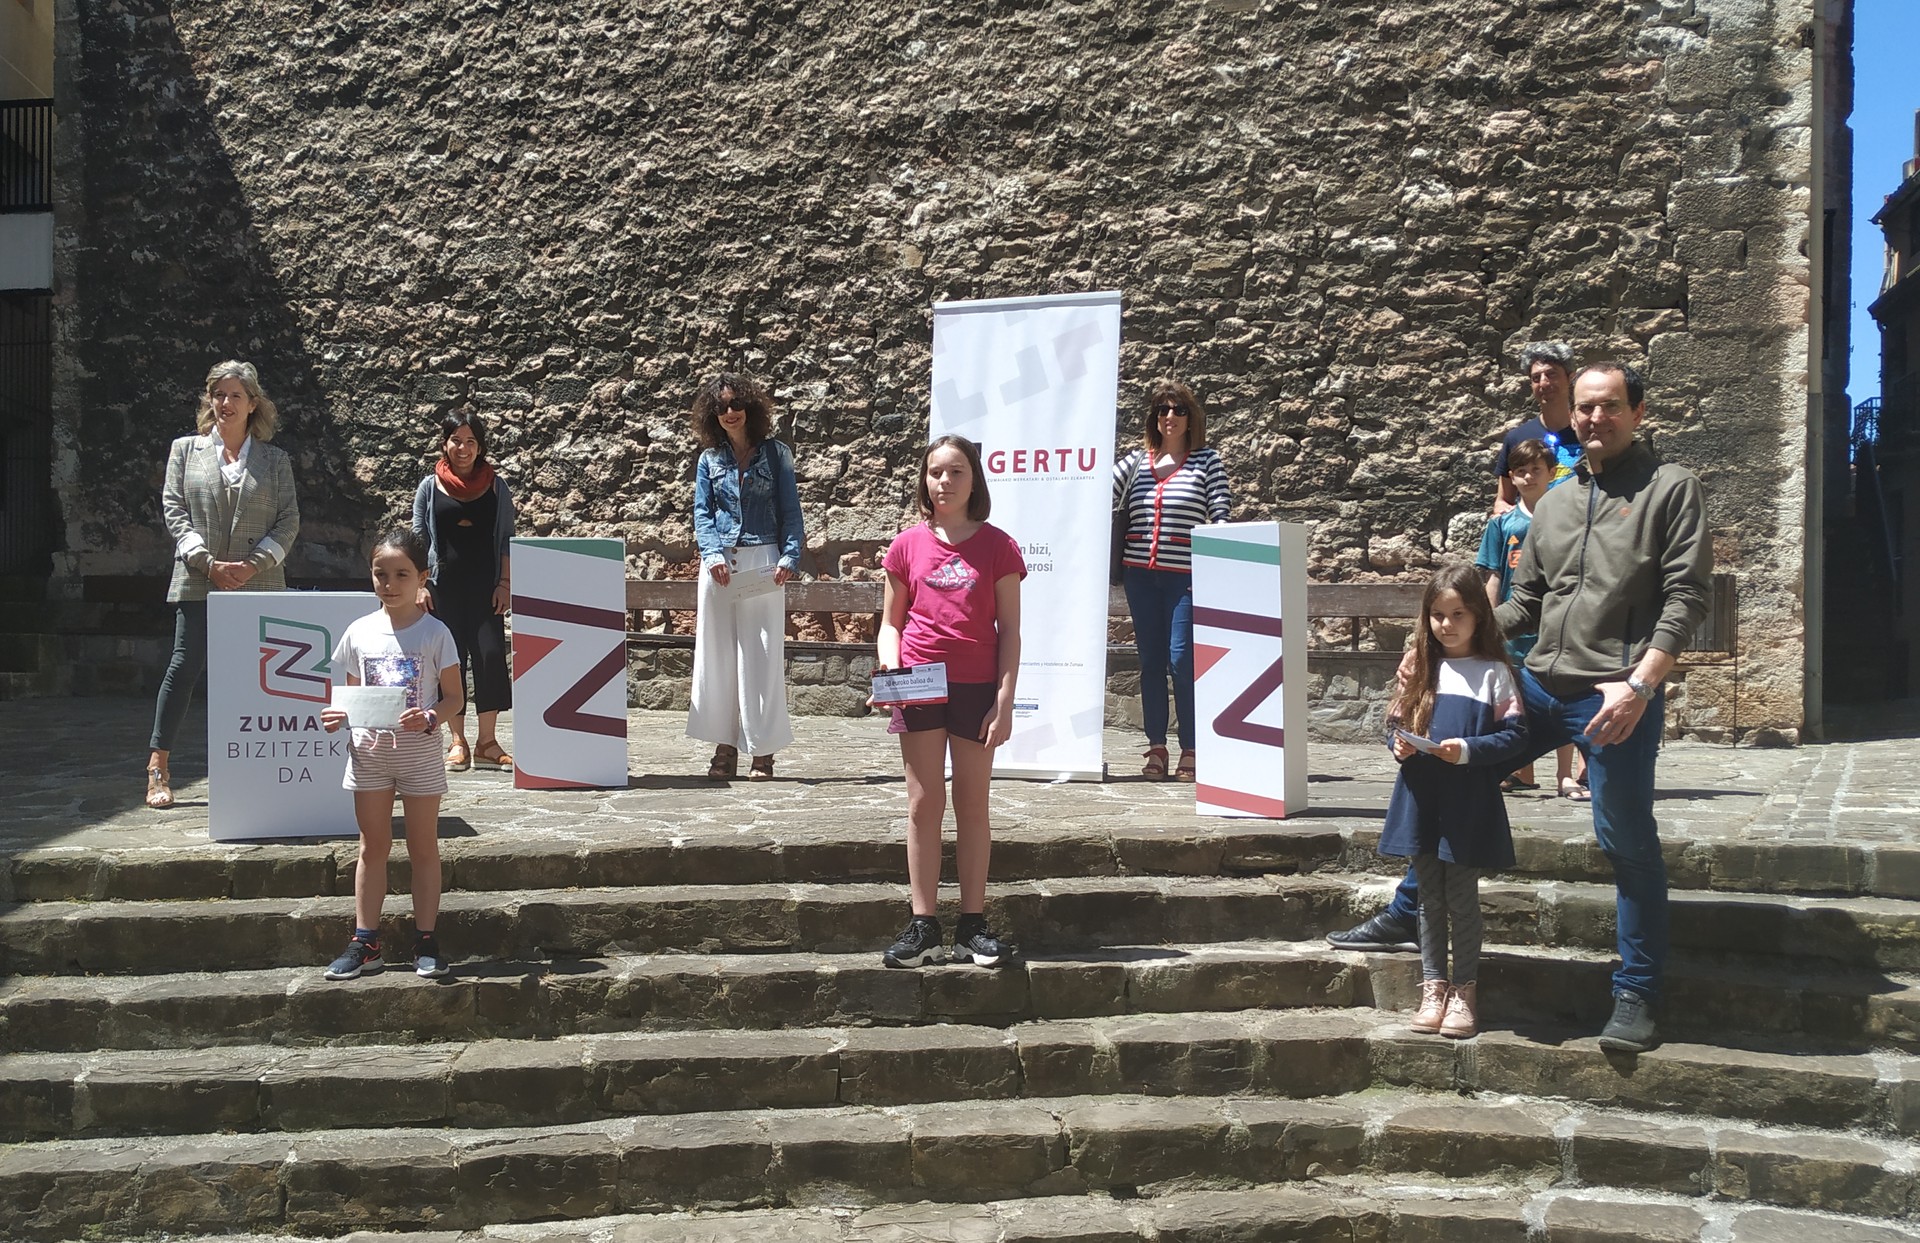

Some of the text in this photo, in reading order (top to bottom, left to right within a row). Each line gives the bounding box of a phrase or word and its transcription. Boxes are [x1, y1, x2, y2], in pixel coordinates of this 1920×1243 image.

[988, 448, 1096, 474] GERTU
[1029, 543, 1051, 556] bizi,
[891, 679, 909, 687] euroko
[239, 716, 351, 732] ZUMA
[278, 767, 313, 783] DA
